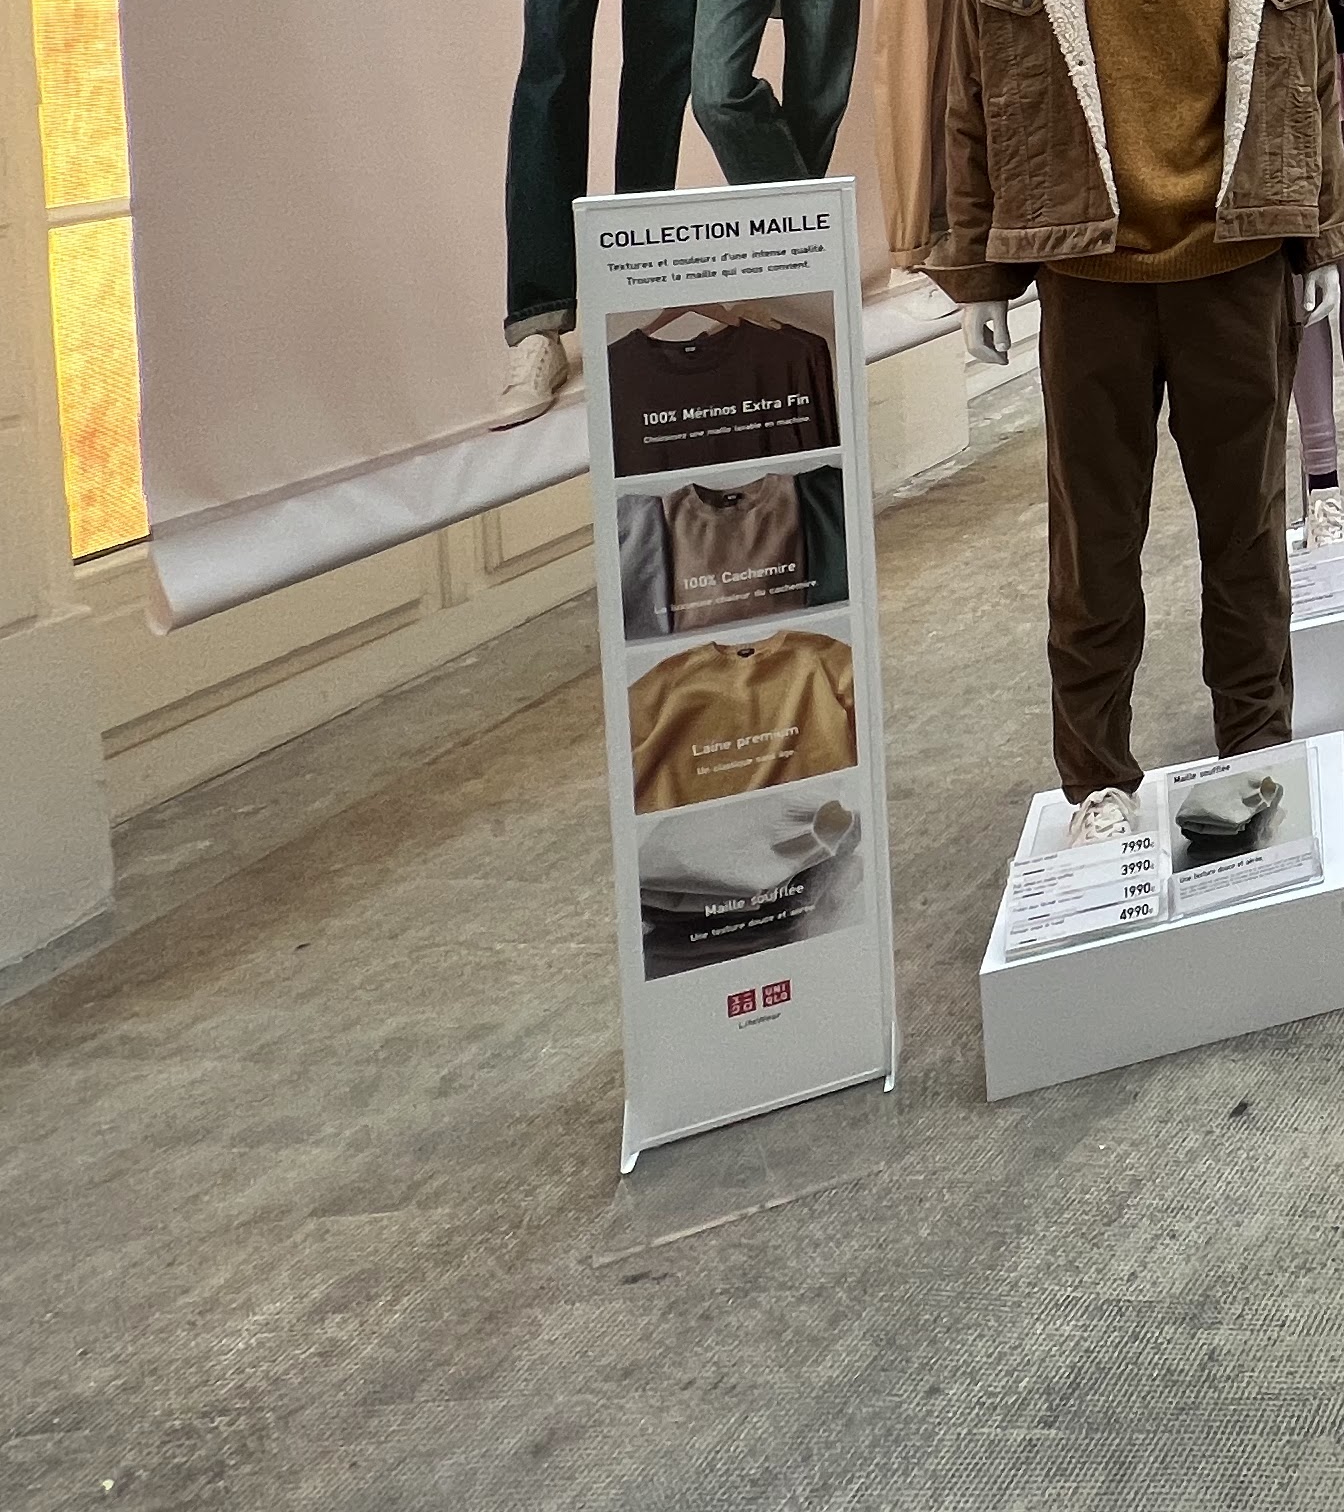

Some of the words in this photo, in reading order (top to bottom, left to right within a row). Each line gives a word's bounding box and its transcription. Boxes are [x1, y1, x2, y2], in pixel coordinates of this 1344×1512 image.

[600, 221, 740, 249] COLLECTION
[749, 213, 831, 236] MAILLE
[607, 261, 654, 273] Textures
[658, 258, 668, 268] et
[672, 255, 717, 266] couleurs
[720, 251, 748, 262] d'une
[752, 248, 787, 259] intense
[626, 275, 667, 286] Trouvez
[671, 272, 682, 281] la
[686, 268, 717, 280] maille
[721, 267, 737, 278] qui
[741, 265, 763, 274] vous
[643, 410, 677, 426] 100%
[682, 404, 737, 421] Mérinos
[742, 400, 782, 413] Extra
[786, 394, 810, 407] Fin
[683, 572, 717, 590] 100%
[721, 561, 796, 584] Cachemire
[691, 738, 732, 757] Laine
[736, 724, 799, 750] premium
[704, 897, 746, 918] Maille
[750, 882, 805, 906] soufflée
